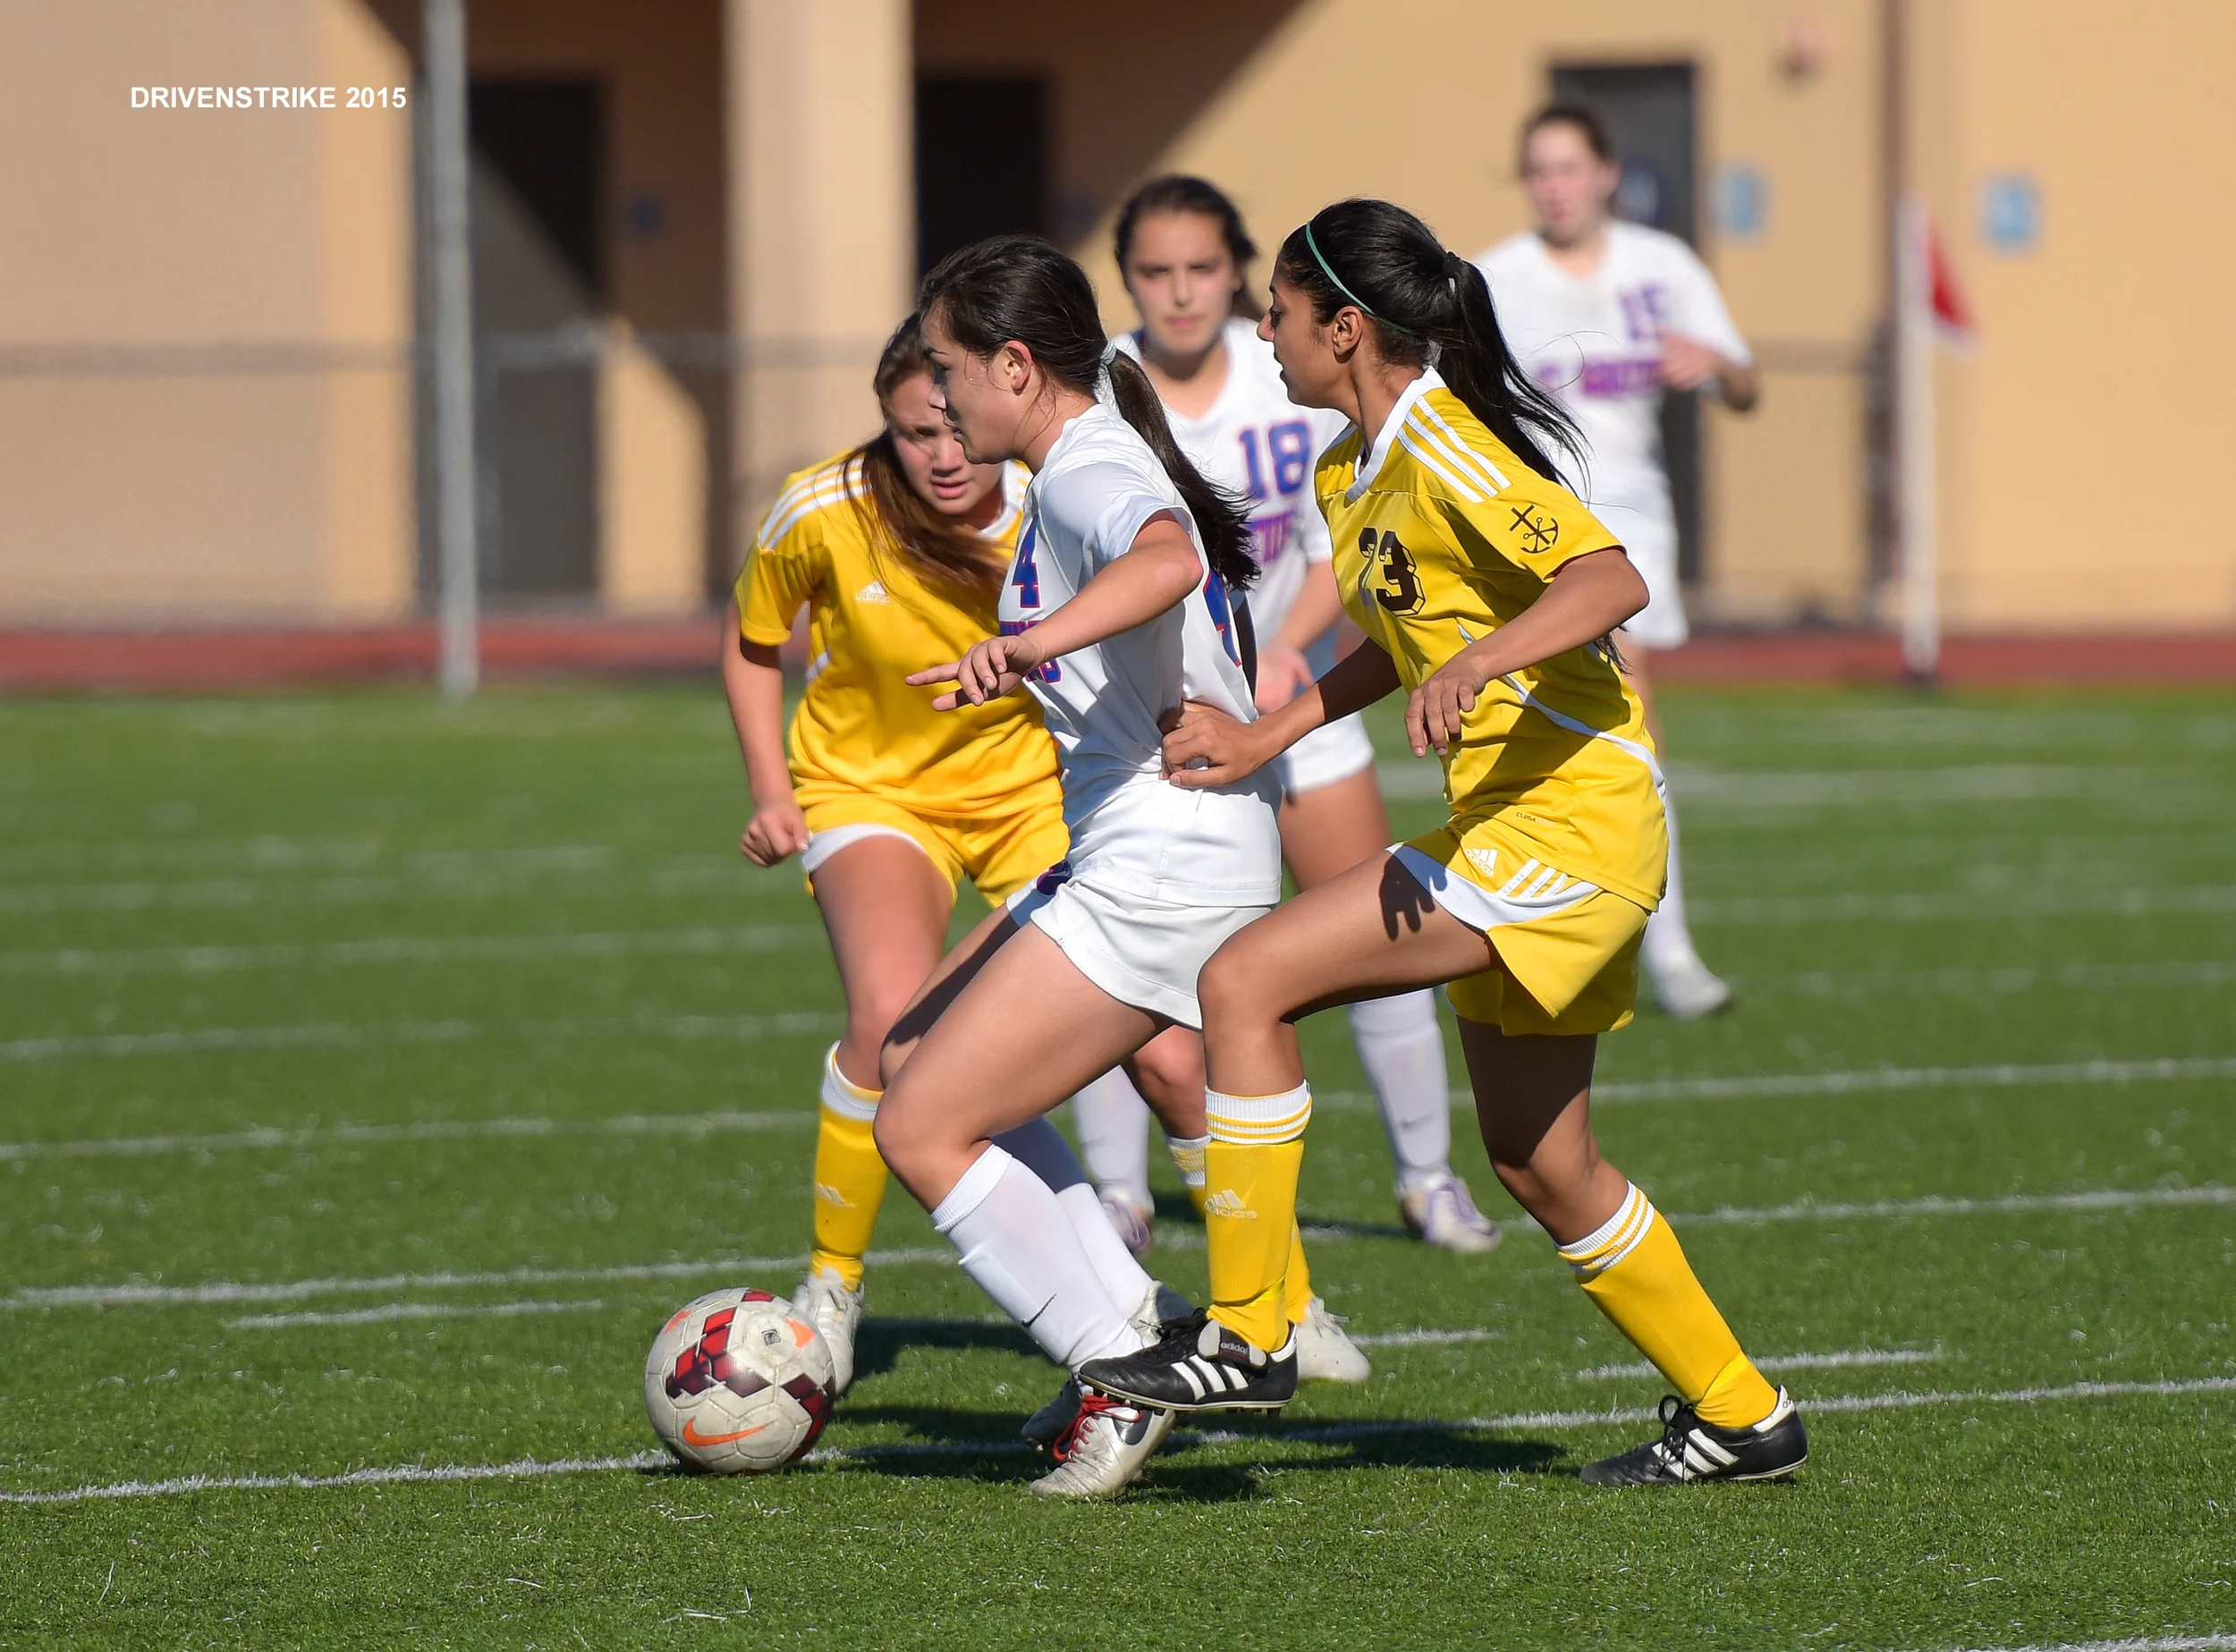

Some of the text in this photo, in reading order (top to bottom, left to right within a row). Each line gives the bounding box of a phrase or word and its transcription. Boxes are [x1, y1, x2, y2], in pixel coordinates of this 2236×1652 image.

[1239, 420, 1312, 501] 18
[1012, 513, 1041, 608] 4
[1357, 527, 1427, 616] 23
